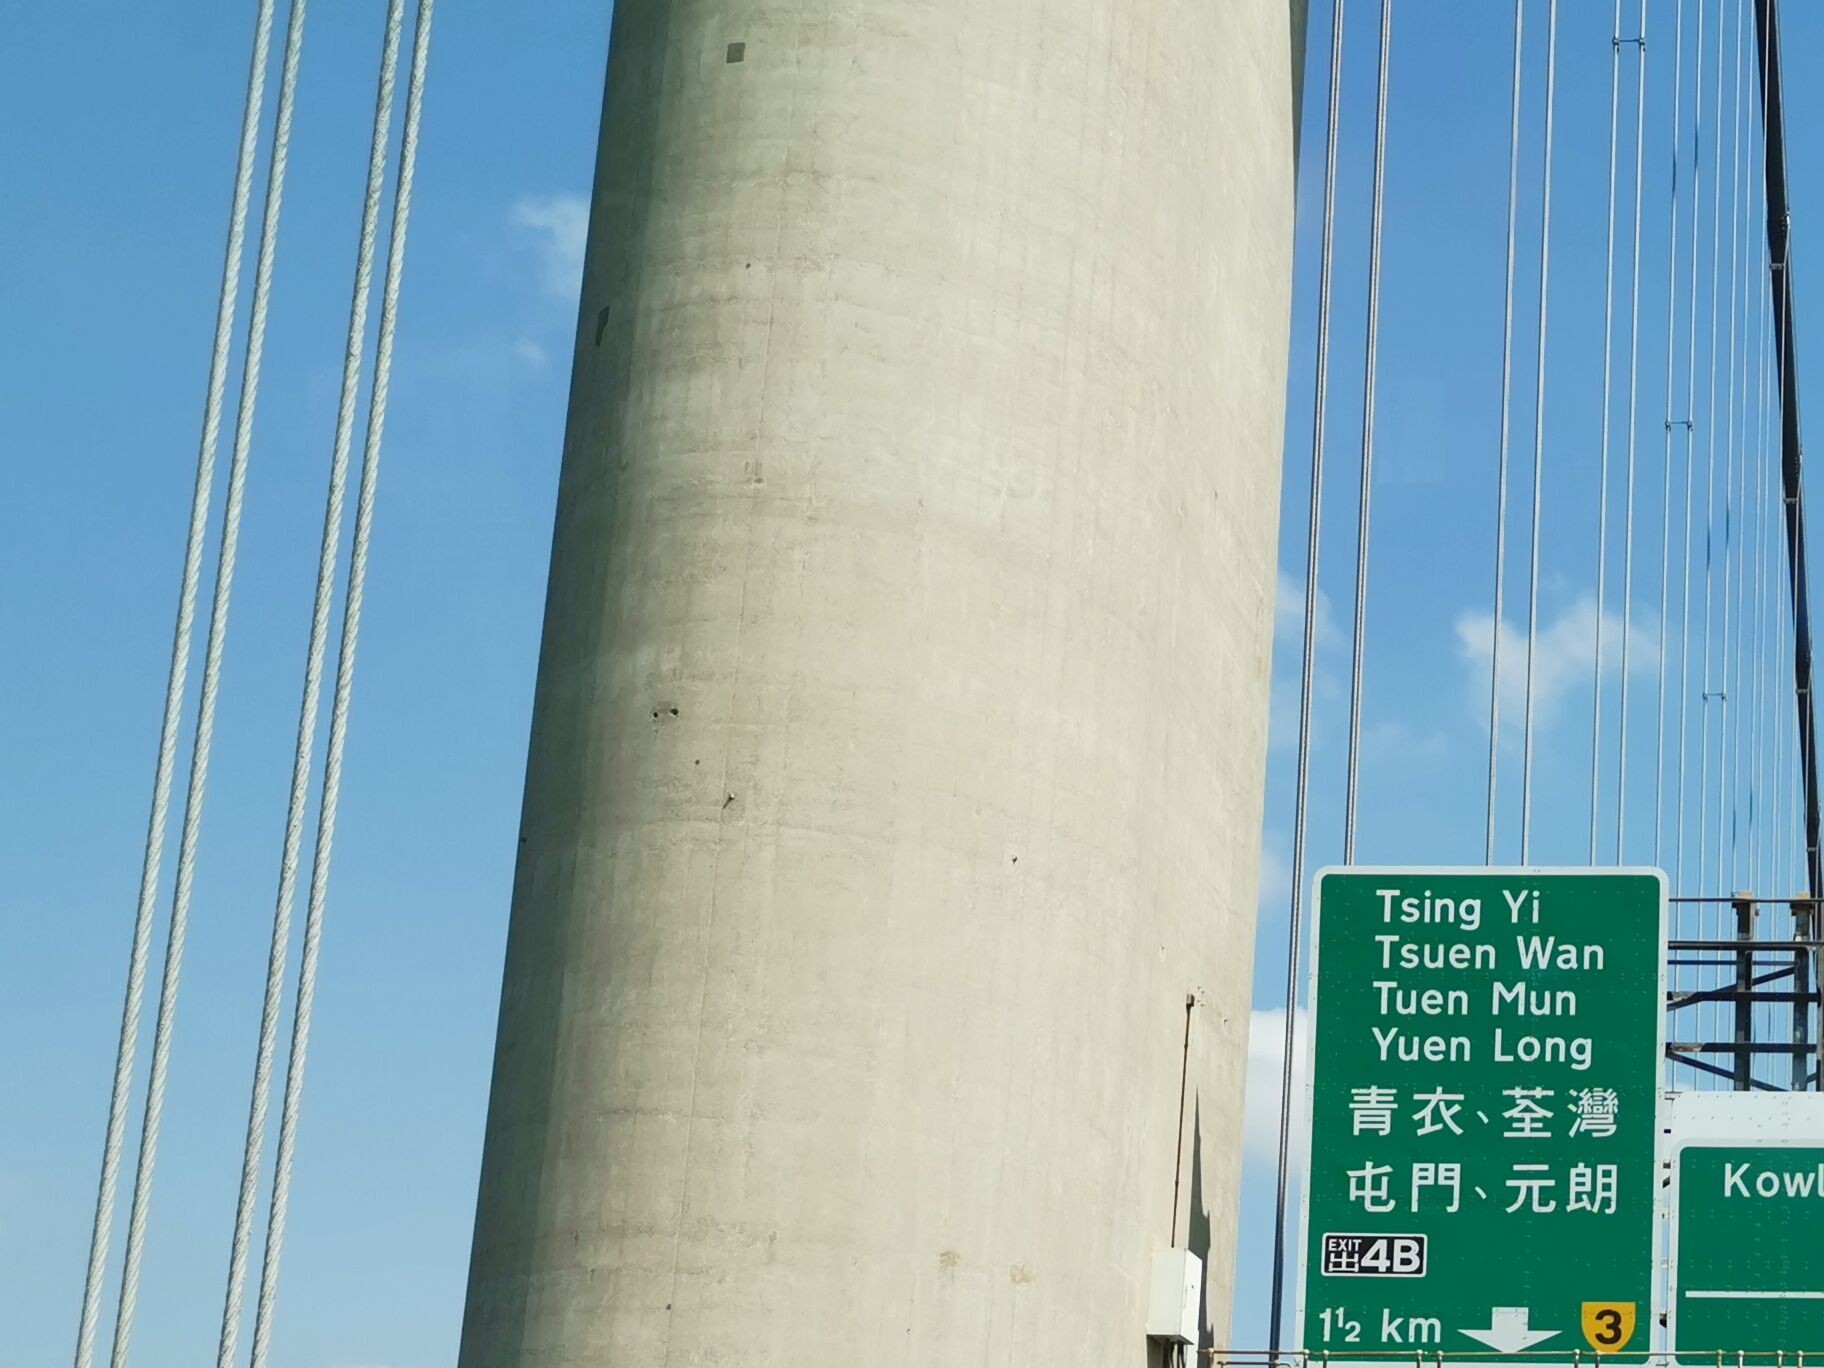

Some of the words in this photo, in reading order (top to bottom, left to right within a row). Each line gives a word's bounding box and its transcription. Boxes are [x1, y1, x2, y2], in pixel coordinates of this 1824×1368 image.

[1376, 889, 1481, 930] Tsing
[1502, 889, 1540, 923] Yi
[1375, 935, 1496, 969] Tsuen
[1516, 935, 1604, 970] Wan
[1373, 981, 1468, 1015] Tuen
[1492, 981, 1576, 1016] Mun
[1372, 1027, 1471, 1062] Yuen
[1494, 1028, 1592, 1070] Long
[1349, 1085, 1619, 1138] 青衣、荃灣
[1346, 1161, 1618, 1214] 屯門、元朗
[1328, 1238, 1362, 1252] EXIT
[1328, 1251, 1360, 1273] 出
[1360, 1239, 1421, 1273] 4B
[1381, 1308, 1441, 1343] km
[1594, 1309, 1623, 1345] 3
